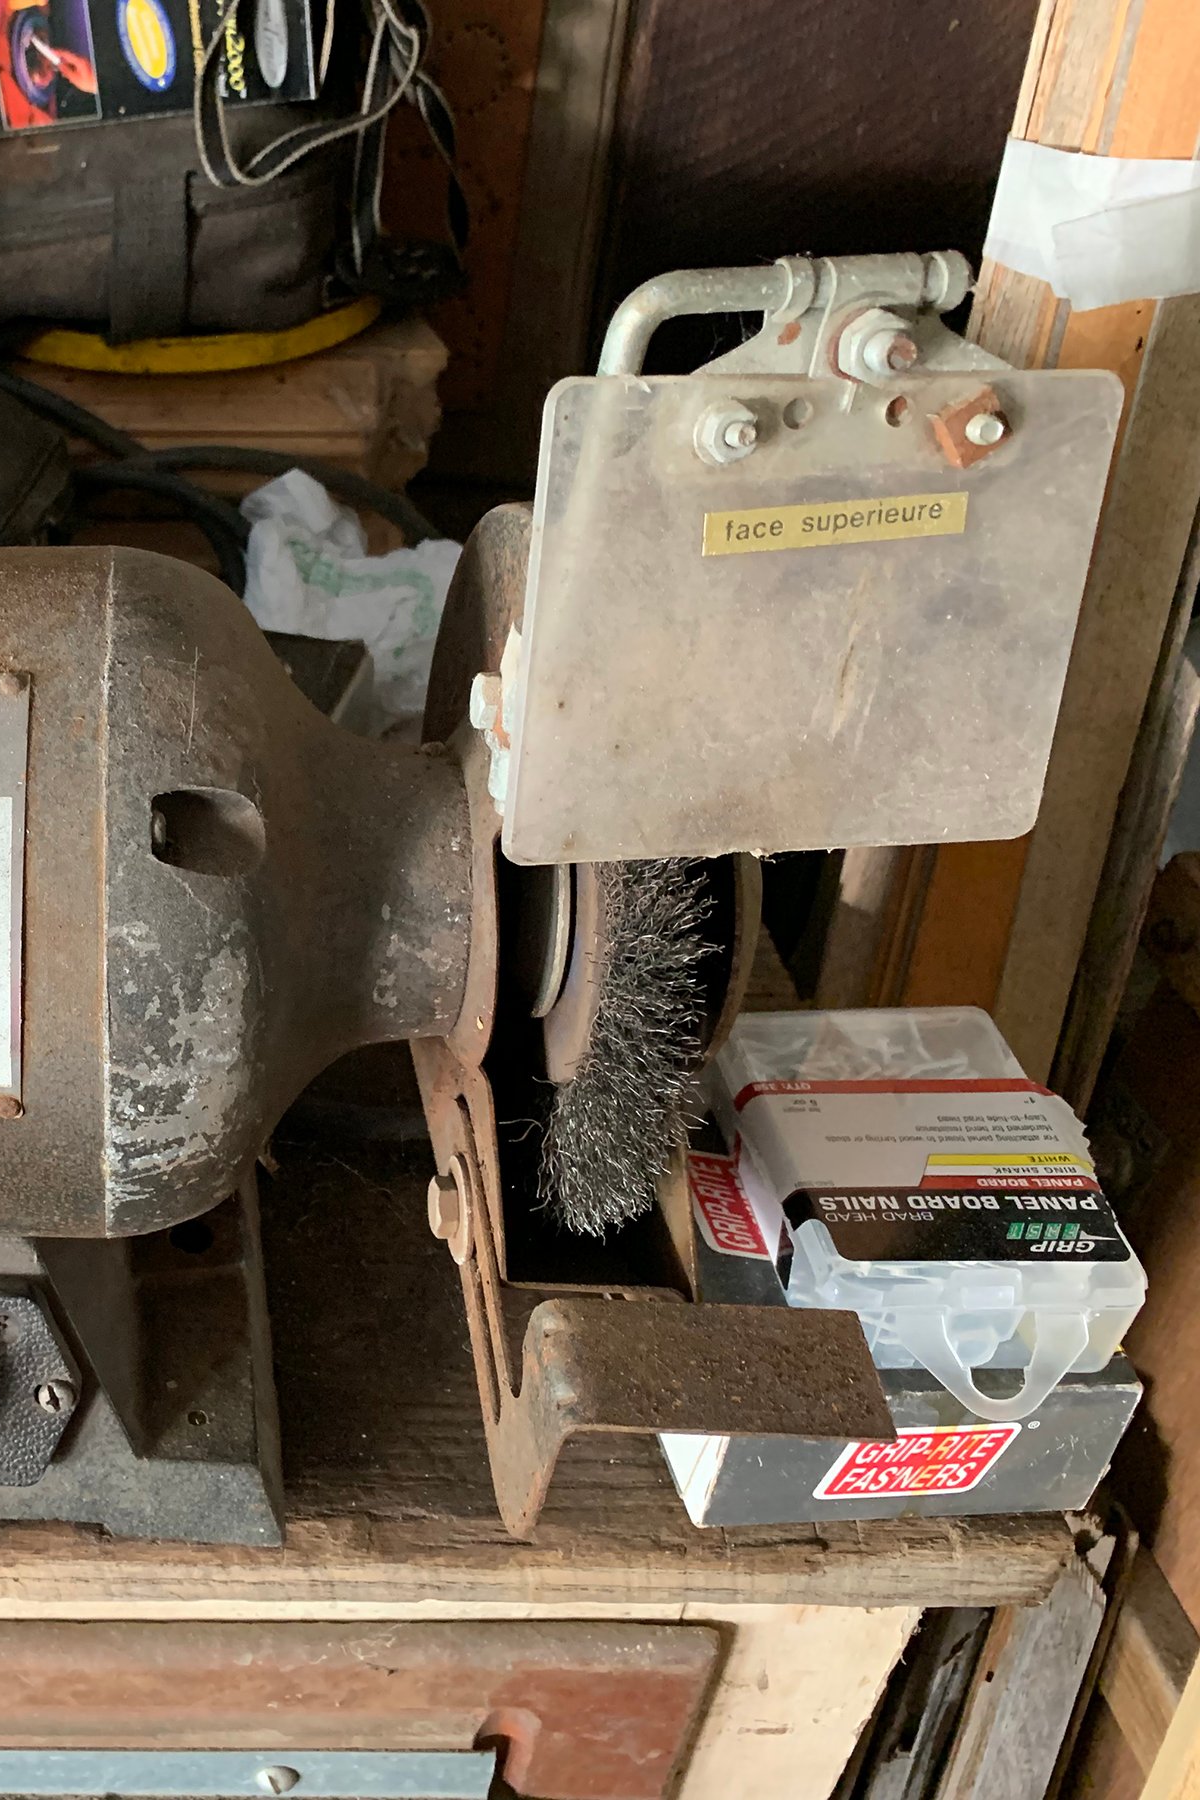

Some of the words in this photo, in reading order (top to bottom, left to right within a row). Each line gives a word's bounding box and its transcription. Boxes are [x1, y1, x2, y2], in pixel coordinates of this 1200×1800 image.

[726, 519, 784, 542] face
[801, 500, 944, 535] superieure
[1027, 1155, 1071, 1163] WHITE
[994, 1166, 1037, 1175] SHANK
[1039, 1166, 1077, 1174] RING
[976, 1178, 1028, 1187] BOARD
[1031, 1178, 1084, 1187] PANEL
[689, 1160, 758, 1249] GRIP-RITE
[818, 1195, 899, 1211] NAILS
[906, 1196, 1000, 1210] BOARD
[1003, 1196, 1099, 1211] PANEL
[825, 1211, 877, 1222] HEAD
[883, 1211, 935, 1222] BRAD
[1029, 1240, 1097, 1253] GRIP
[854, 1432, 1004, 1464] GRIP-RITE
[833, 1461, 977, 1493] FAS'NERS
